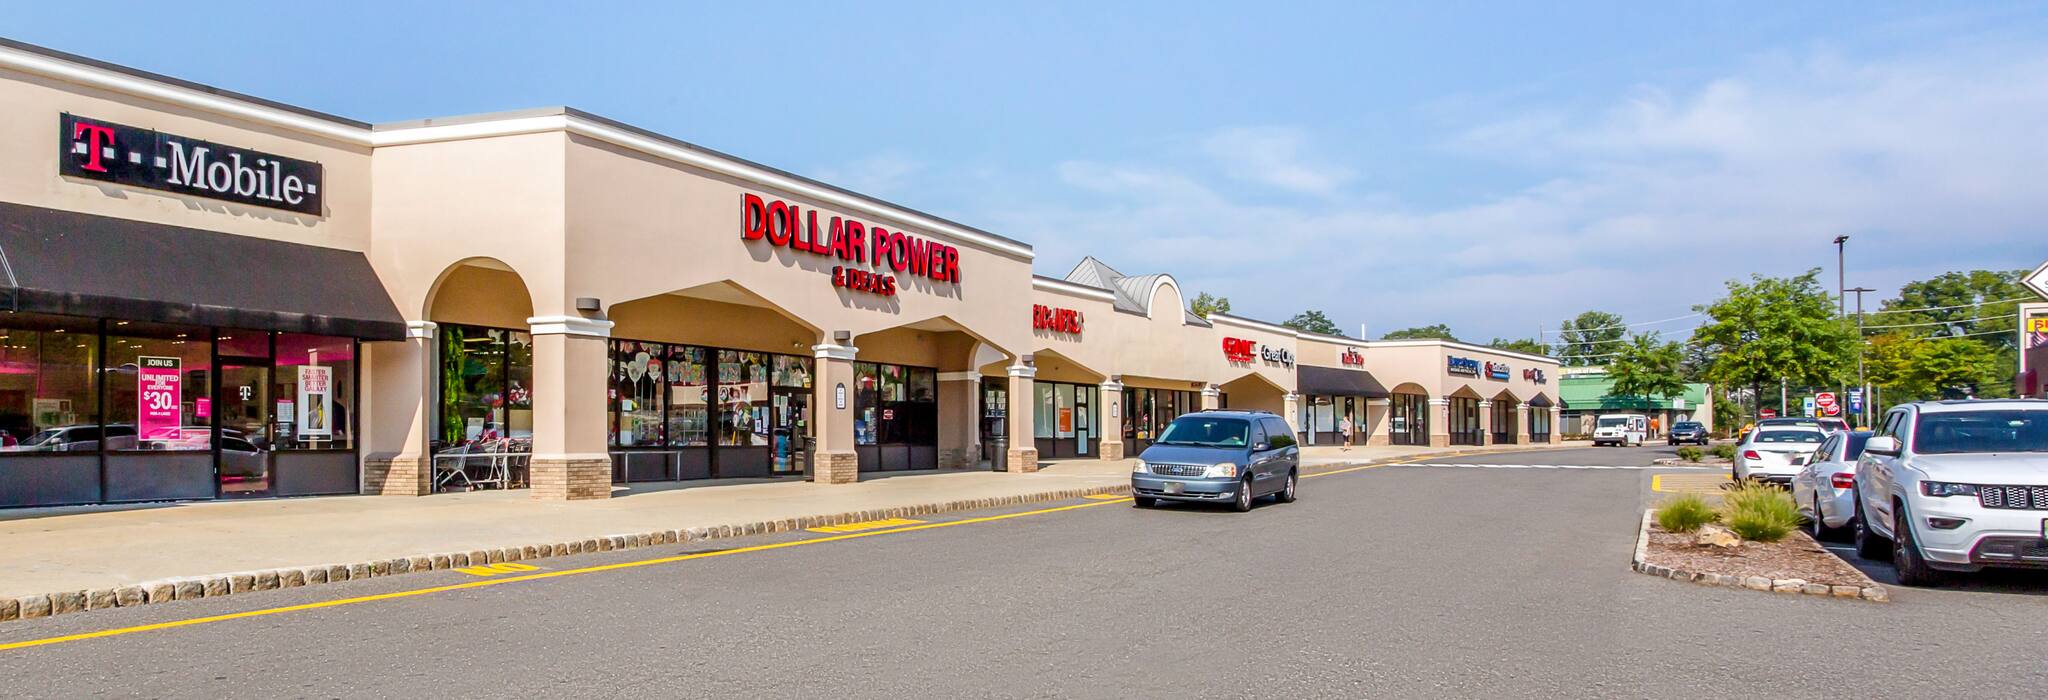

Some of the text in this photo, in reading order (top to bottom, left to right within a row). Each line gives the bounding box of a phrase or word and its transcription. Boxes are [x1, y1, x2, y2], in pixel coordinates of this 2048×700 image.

[167, 141, 304, 205] Mobile
[741, 192, 960, 284] DOLLAR POWER
[832, 266, 896, 297] & DEALS
[141, 373, 179, 382] UNLIMITED
[143, 391, 172, 410] $30
